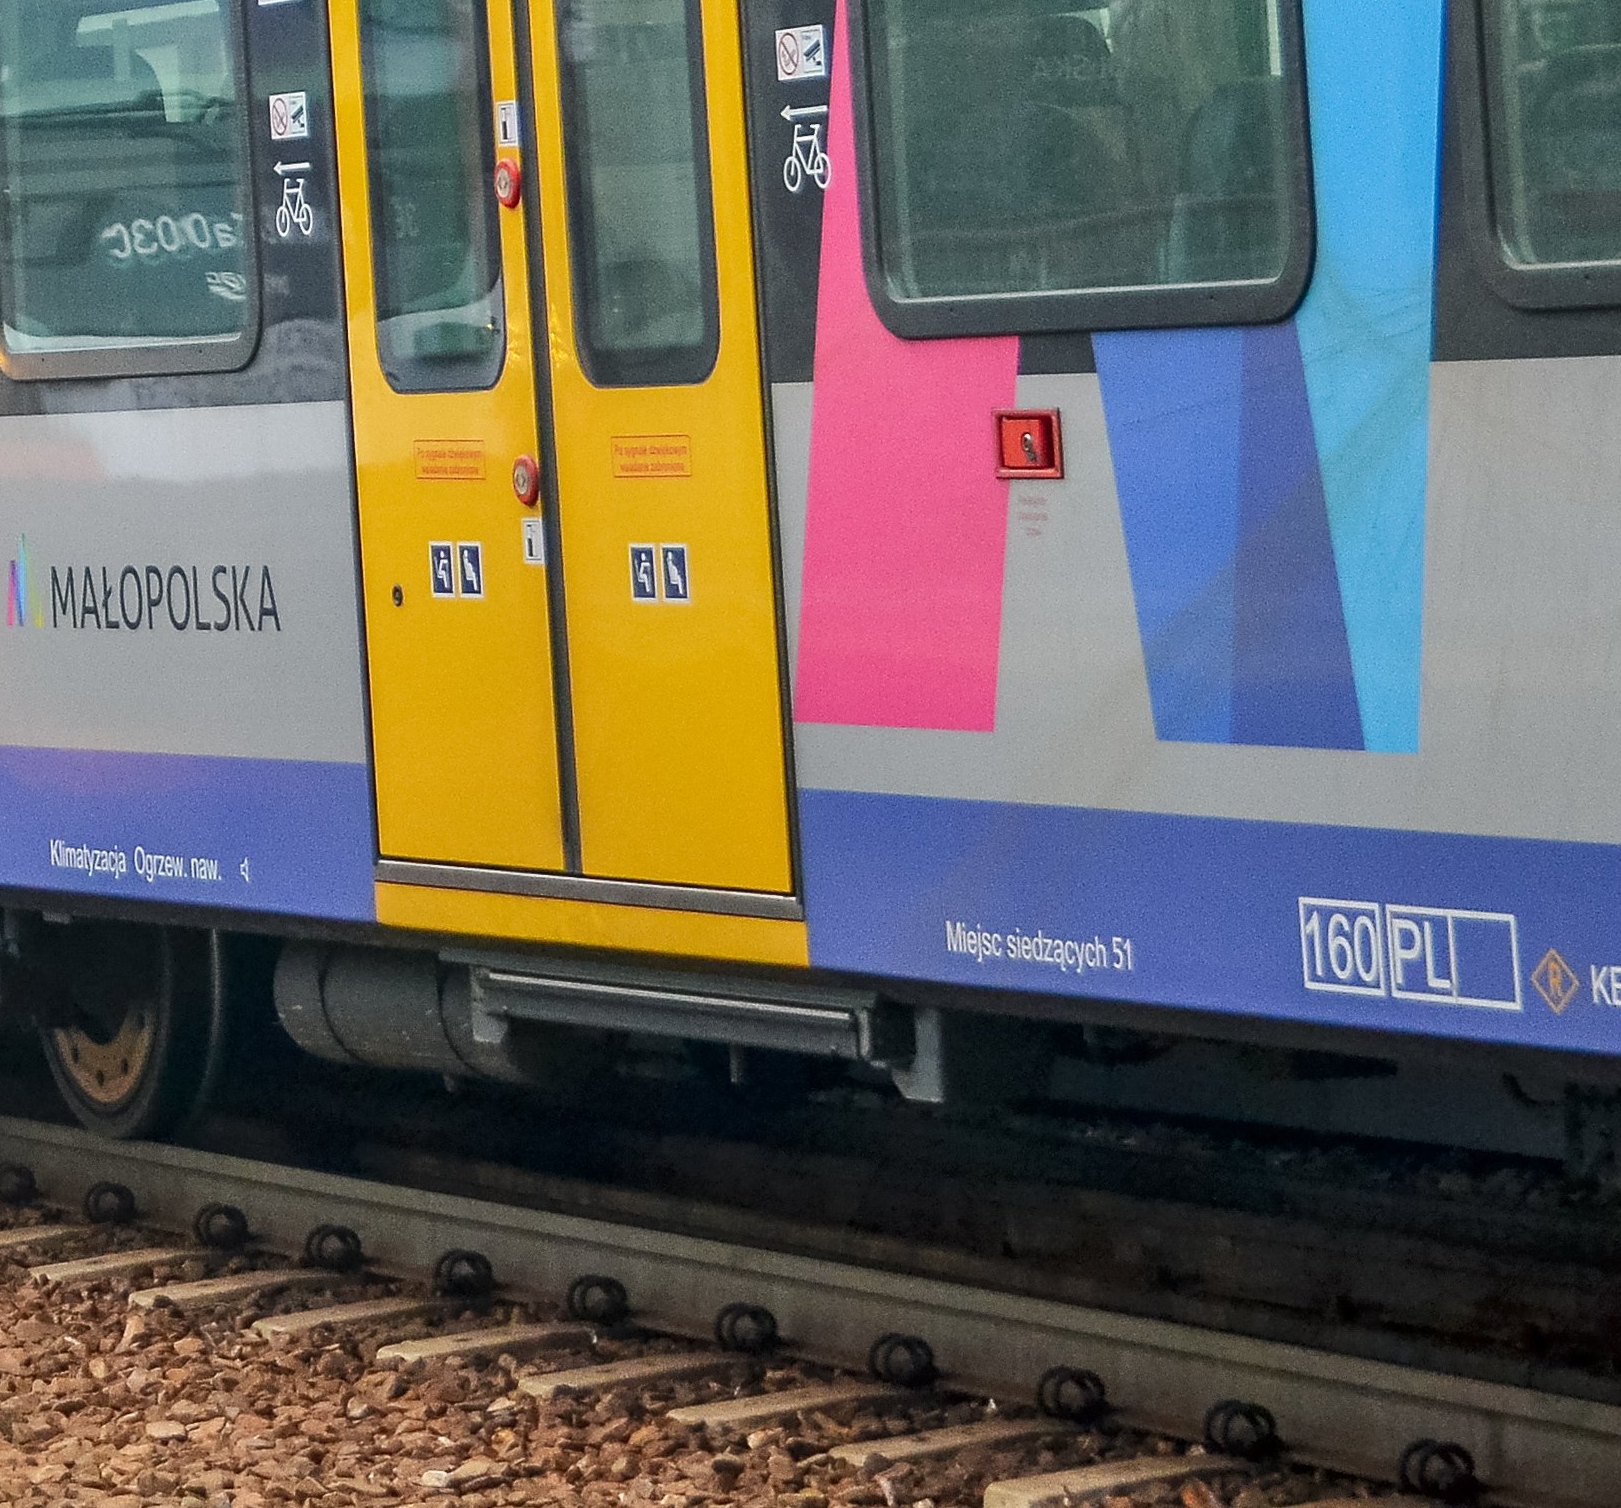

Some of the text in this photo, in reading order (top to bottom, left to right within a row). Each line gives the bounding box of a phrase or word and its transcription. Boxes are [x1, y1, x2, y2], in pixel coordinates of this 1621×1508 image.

[50, 564, 282, 632] MAŁOPOLSKA
[50, 838, 223, 882] Klimatyzacja Ogrzew. naw.
[945, 920, 1134, 974] Miejsc siedzących 51
[1305, 910, 1452, 988] 160 PL
